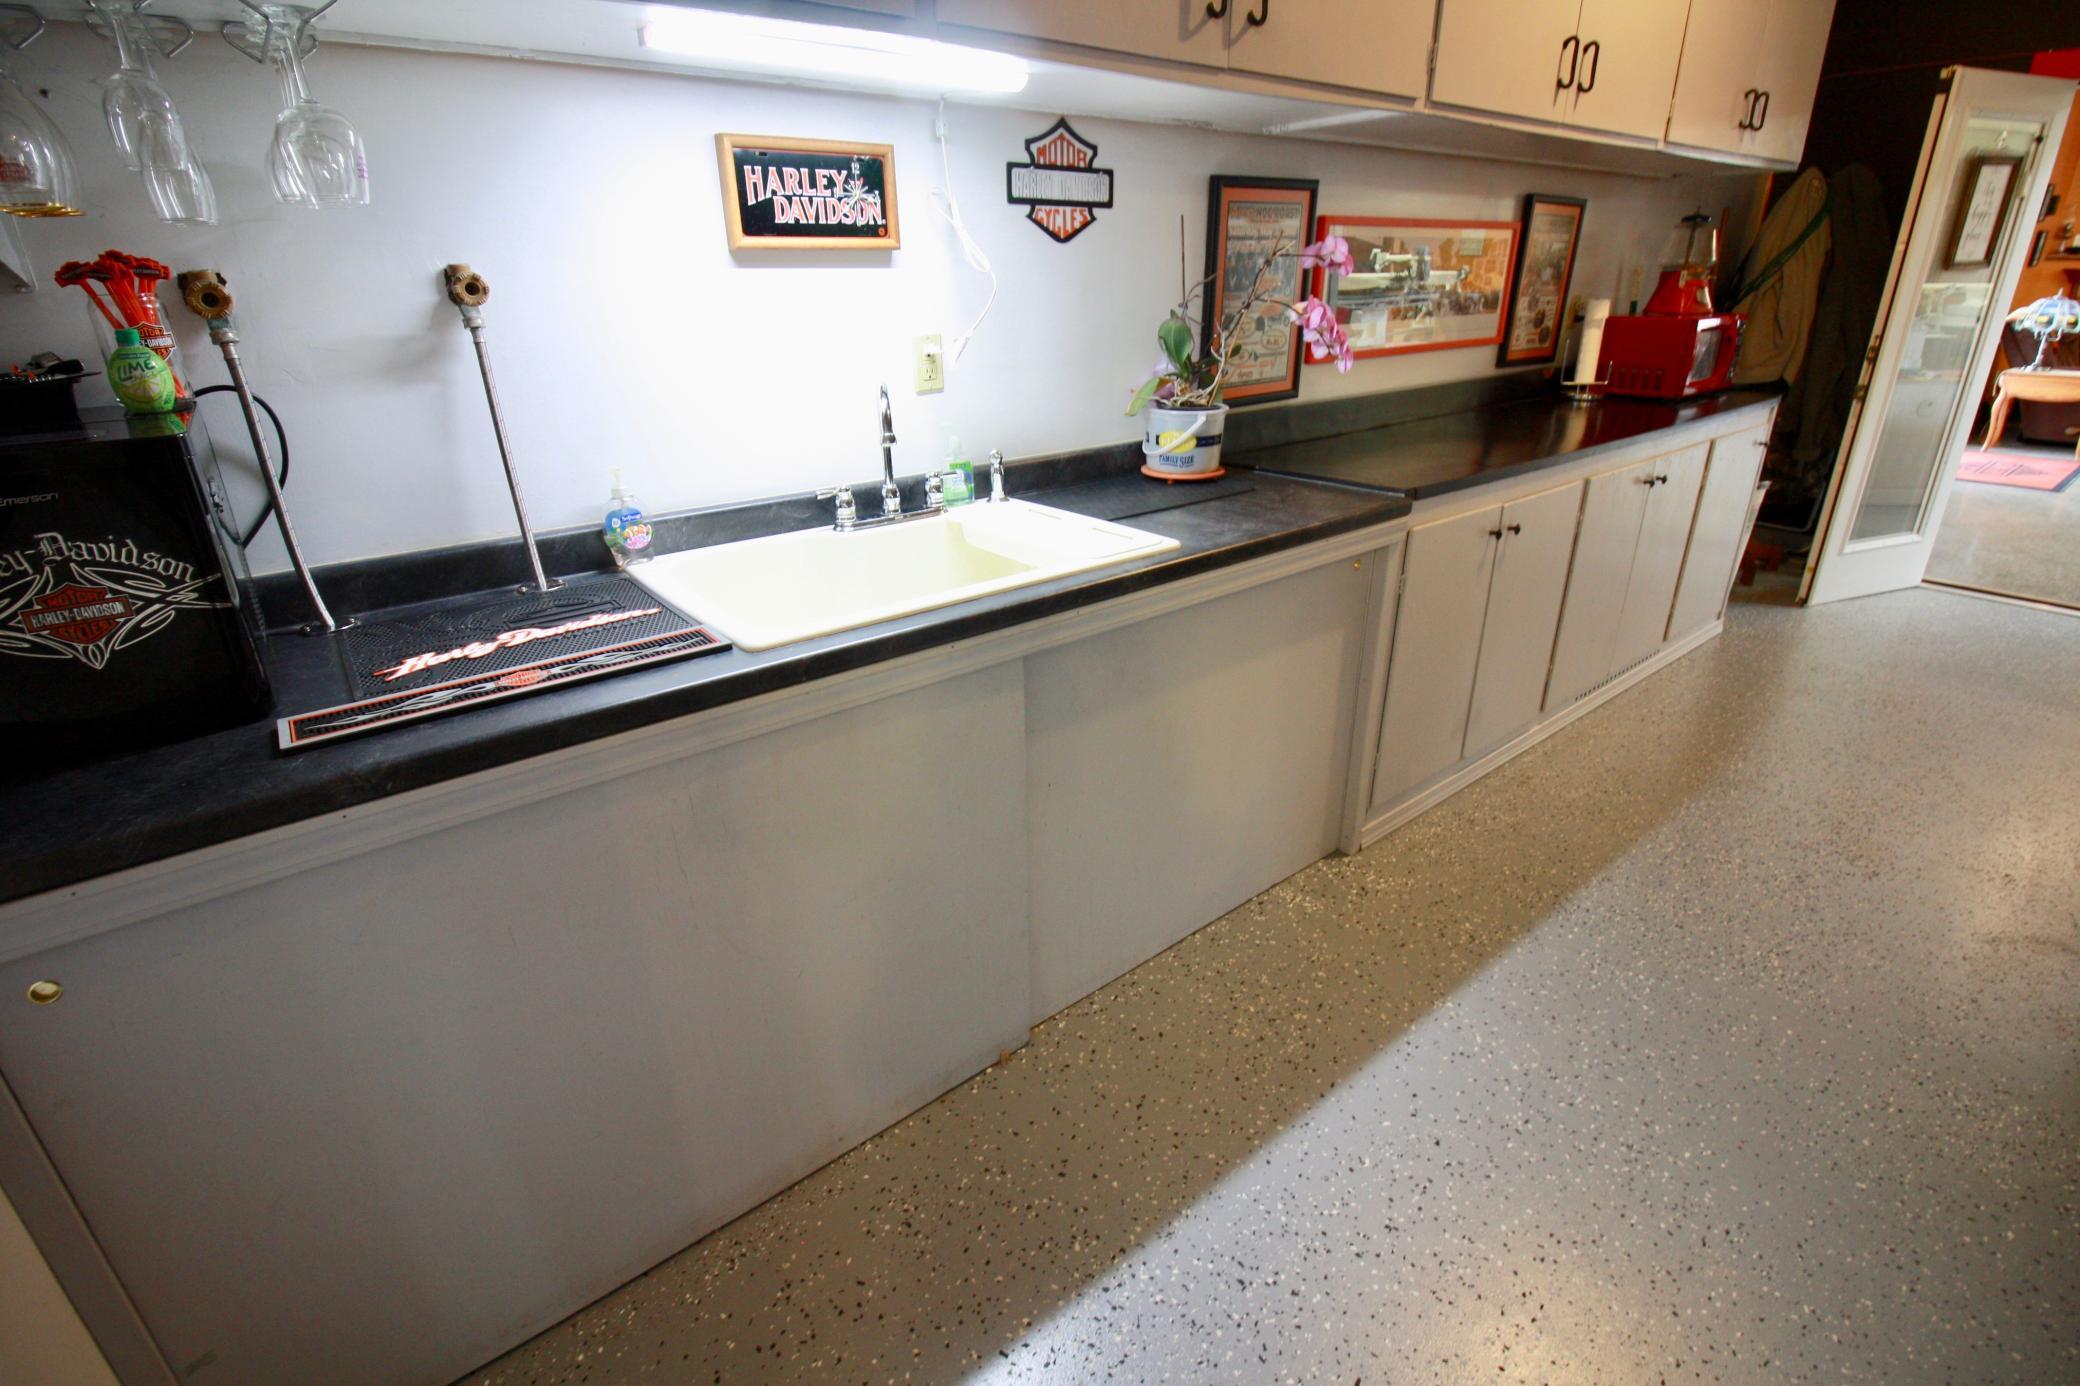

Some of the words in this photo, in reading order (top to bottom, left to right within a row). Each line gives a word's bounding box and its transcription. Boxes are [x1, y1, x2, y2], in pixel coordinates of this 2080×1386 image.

[1036, 132, 1088, 169] MOTOR
[743, 165, 848, 206] HARLEY
[1032, 206, 1089, 240] CYCLES
[117, 360, 156, 382] LIME
[1159, 455, 1179, 465] FAMILY
[1179, 454, 1195, 466] SIZE
[30, 601, 126, 629] HARLEY-DAVIDSON
